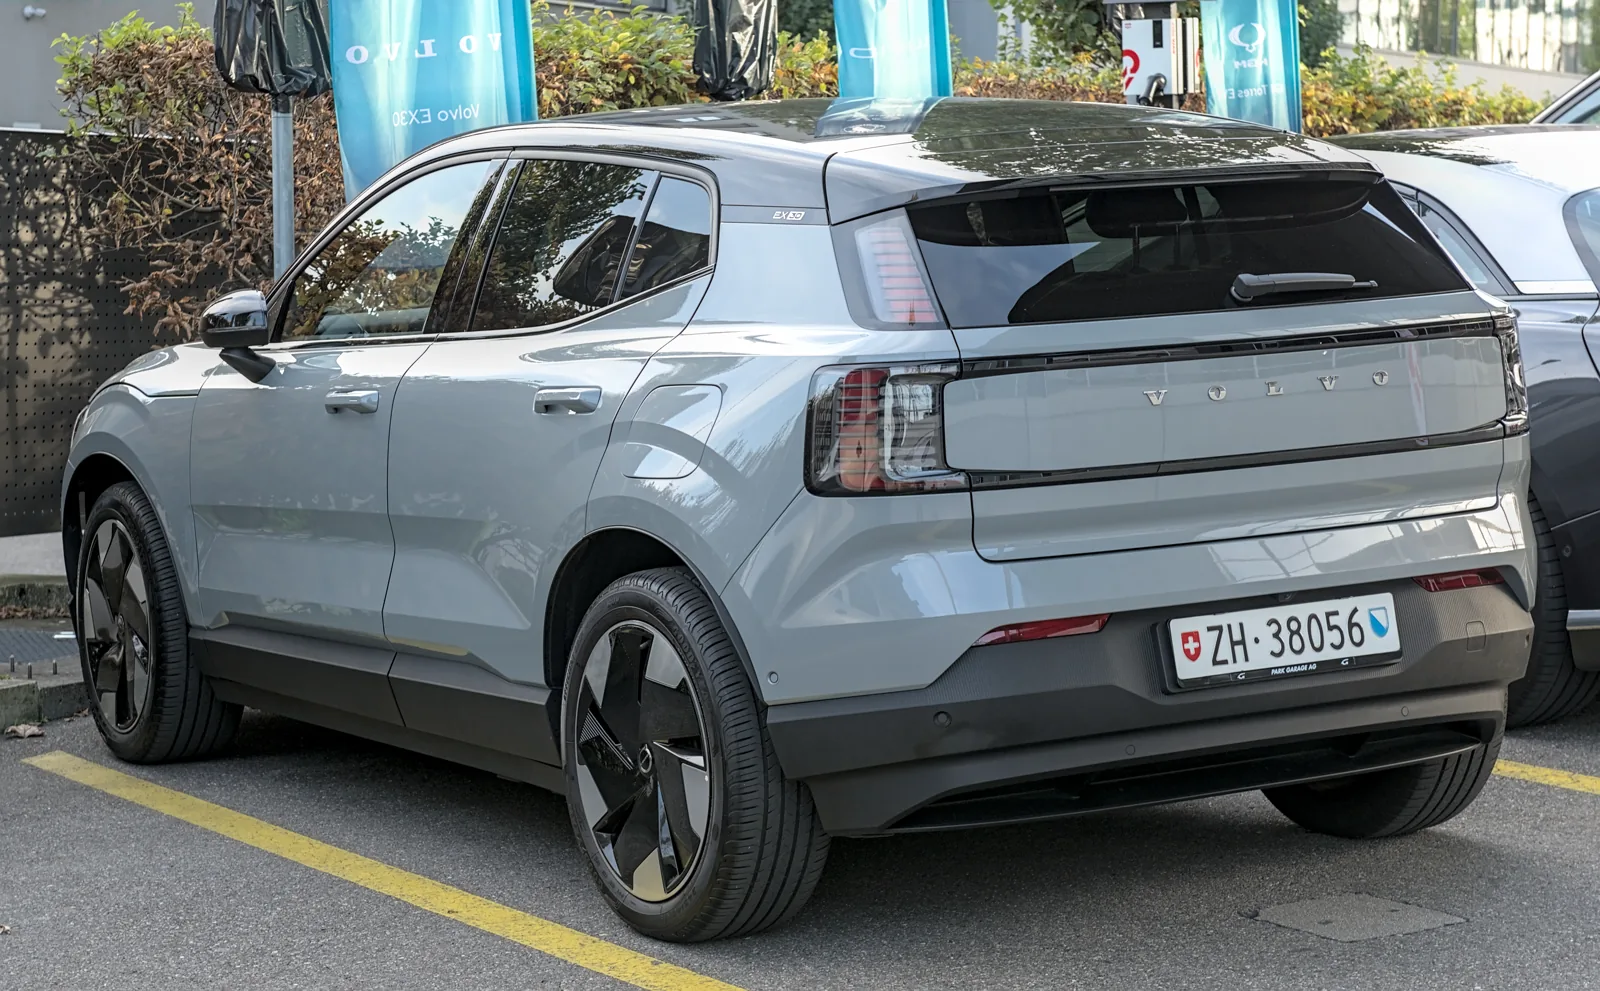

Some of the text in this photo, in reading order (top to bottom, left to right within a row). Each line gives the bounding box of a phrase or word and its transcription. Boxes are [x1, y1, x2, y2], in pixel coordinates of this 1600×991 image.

[772, 210, 806, 220] EX30
[1143, 369, 1389, 406] VOLVO
[1271, 667, 1285, 675] PARK
[1286, 664, 1308, 673] GARAGE
